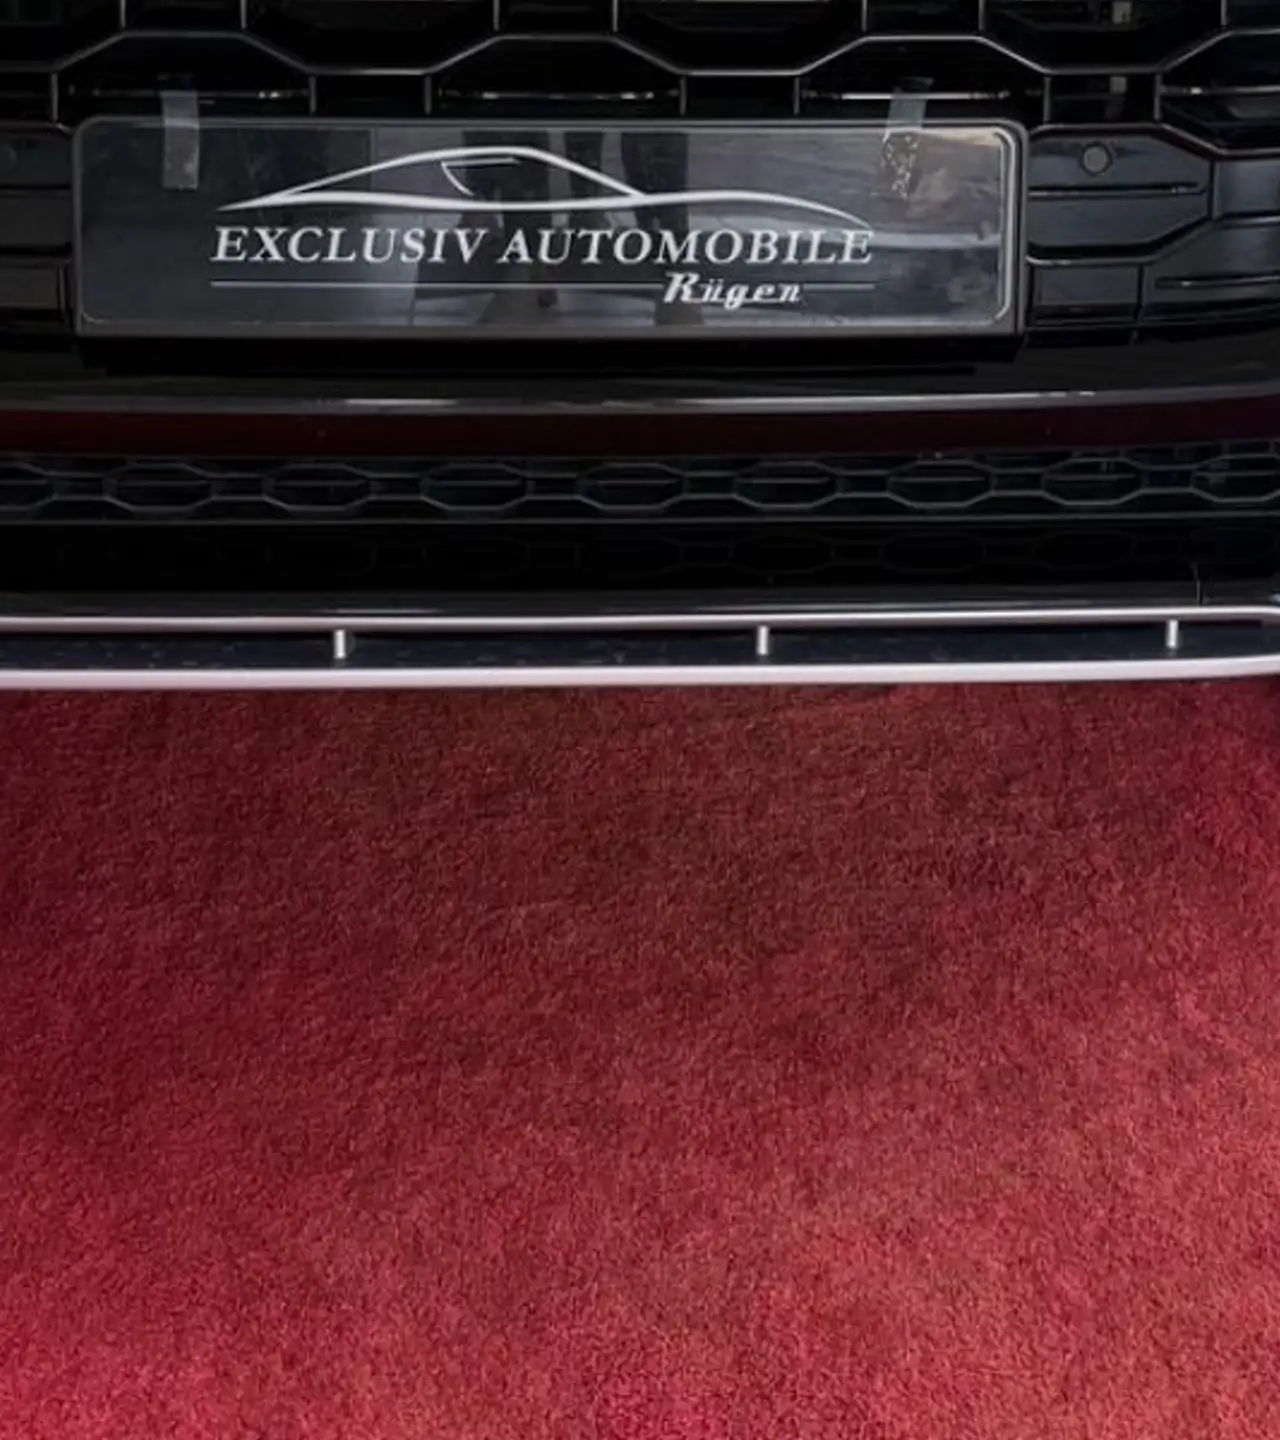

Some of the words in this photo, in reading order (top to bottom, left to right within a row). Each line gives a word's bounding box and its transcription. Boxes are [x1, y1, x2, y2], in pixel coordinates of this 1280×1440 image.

[211, 224, 485, 264] EXCLUSIV
[498, 224, 874, 264] AUTOMOBILE
[663, 270, 803, 308] Rügen
